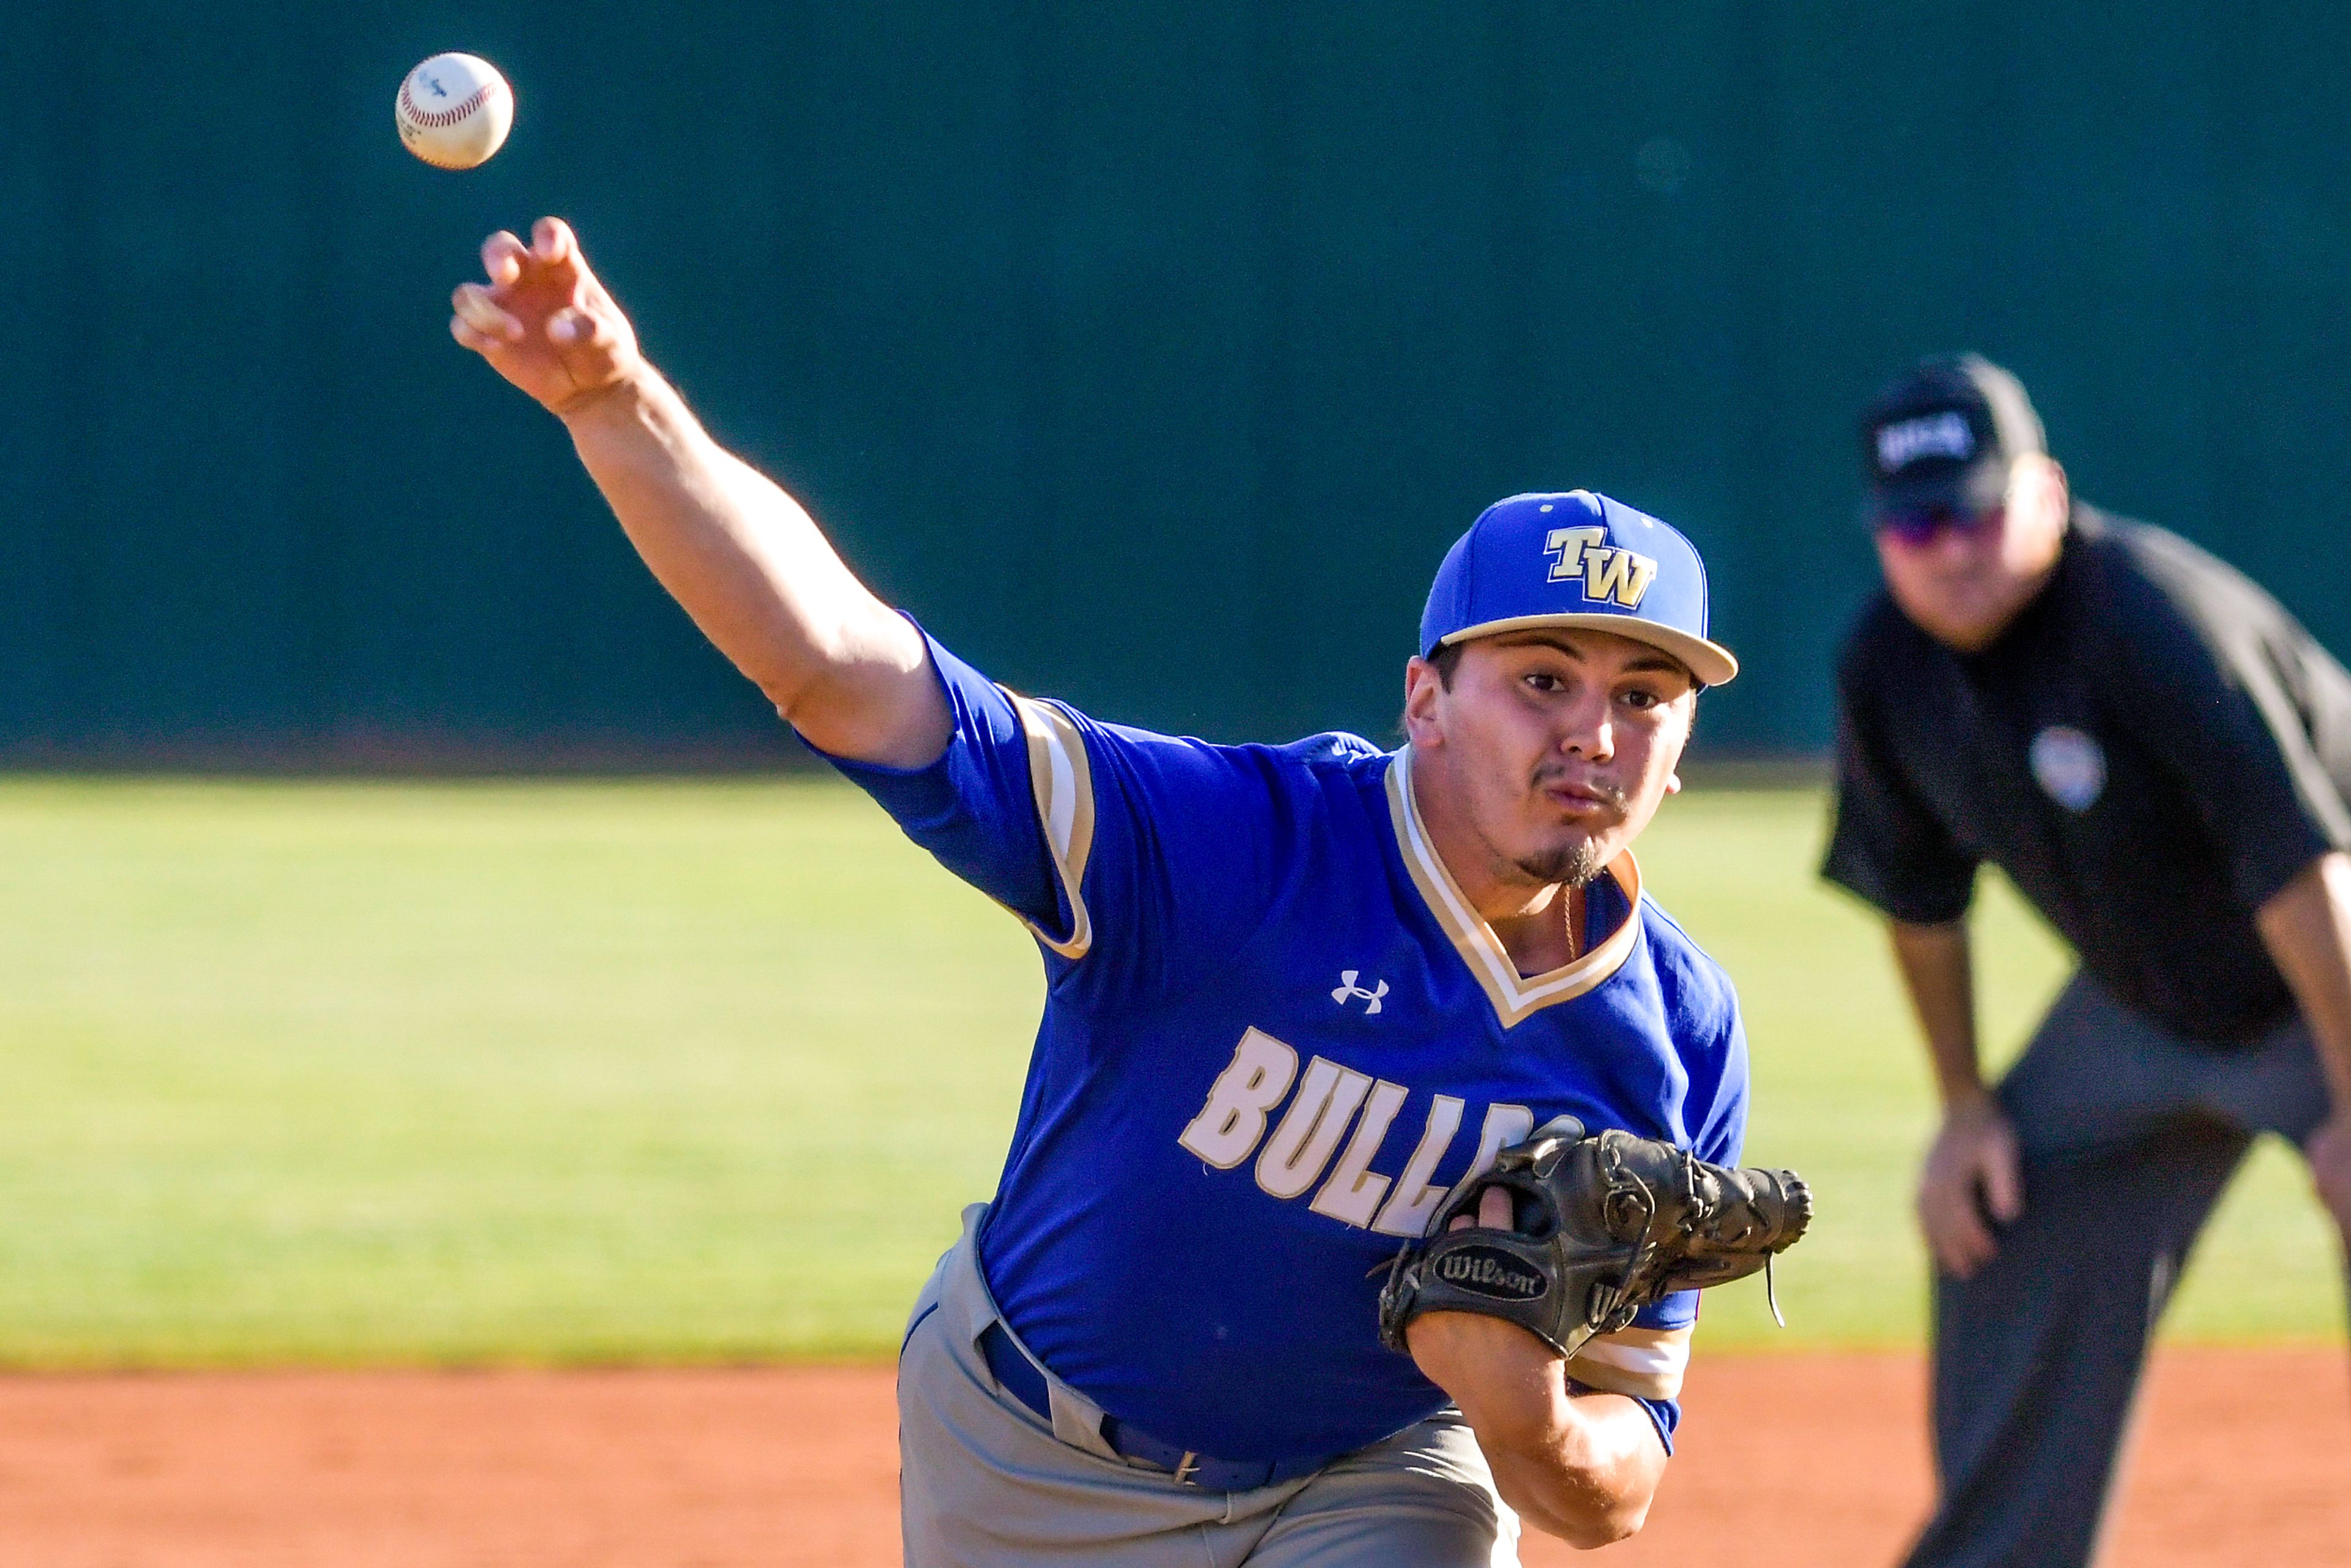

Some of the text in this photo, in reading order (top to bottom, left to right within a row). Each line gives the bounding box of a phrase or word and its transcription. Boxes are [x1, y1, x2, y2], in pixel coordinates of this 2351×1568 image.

[1543, 526, 1658, 610] TW
[1177, 1026, 1586, 1239] BULL
[1444, 1256, 1541, 1294] Wilson
